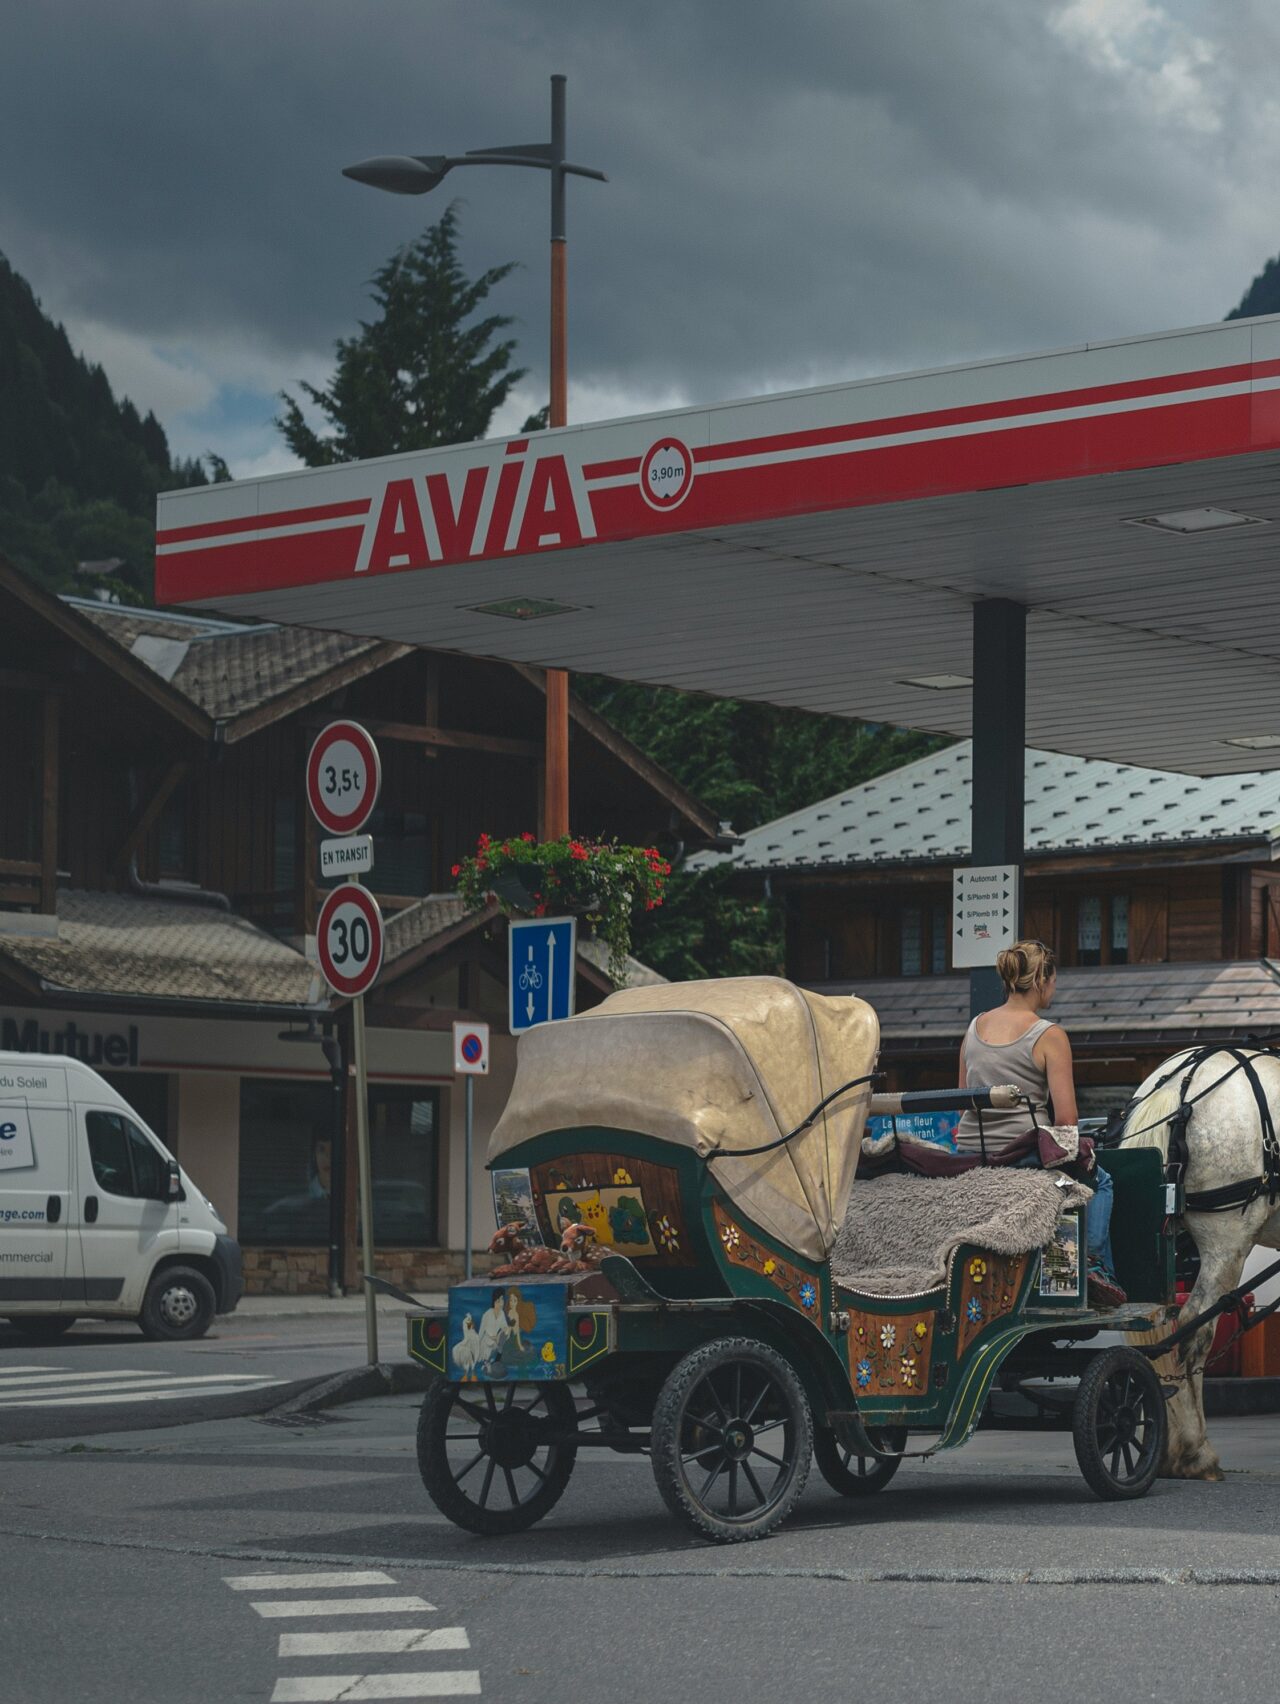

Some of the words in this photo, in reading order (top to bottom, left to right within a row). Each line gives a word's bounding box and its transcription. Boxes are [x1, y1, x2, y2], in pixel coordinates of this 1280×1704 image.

[363, 438, 590, 572] AVIA
[324, 765, 361, 797] 3,5t
[323, 849, 334, 865] EN
[335, 846, 369, 863] TRANSIT
[970, 874, 998, 883] Automat
[331, 916, 370, 964] 30
[2, 1018, 139, 1067] Mutuel
[17, 1077, 48, 1089] Soleil
[882, 1118, 893, 1129] La
[914, 1116, 934, 1127] fleur
